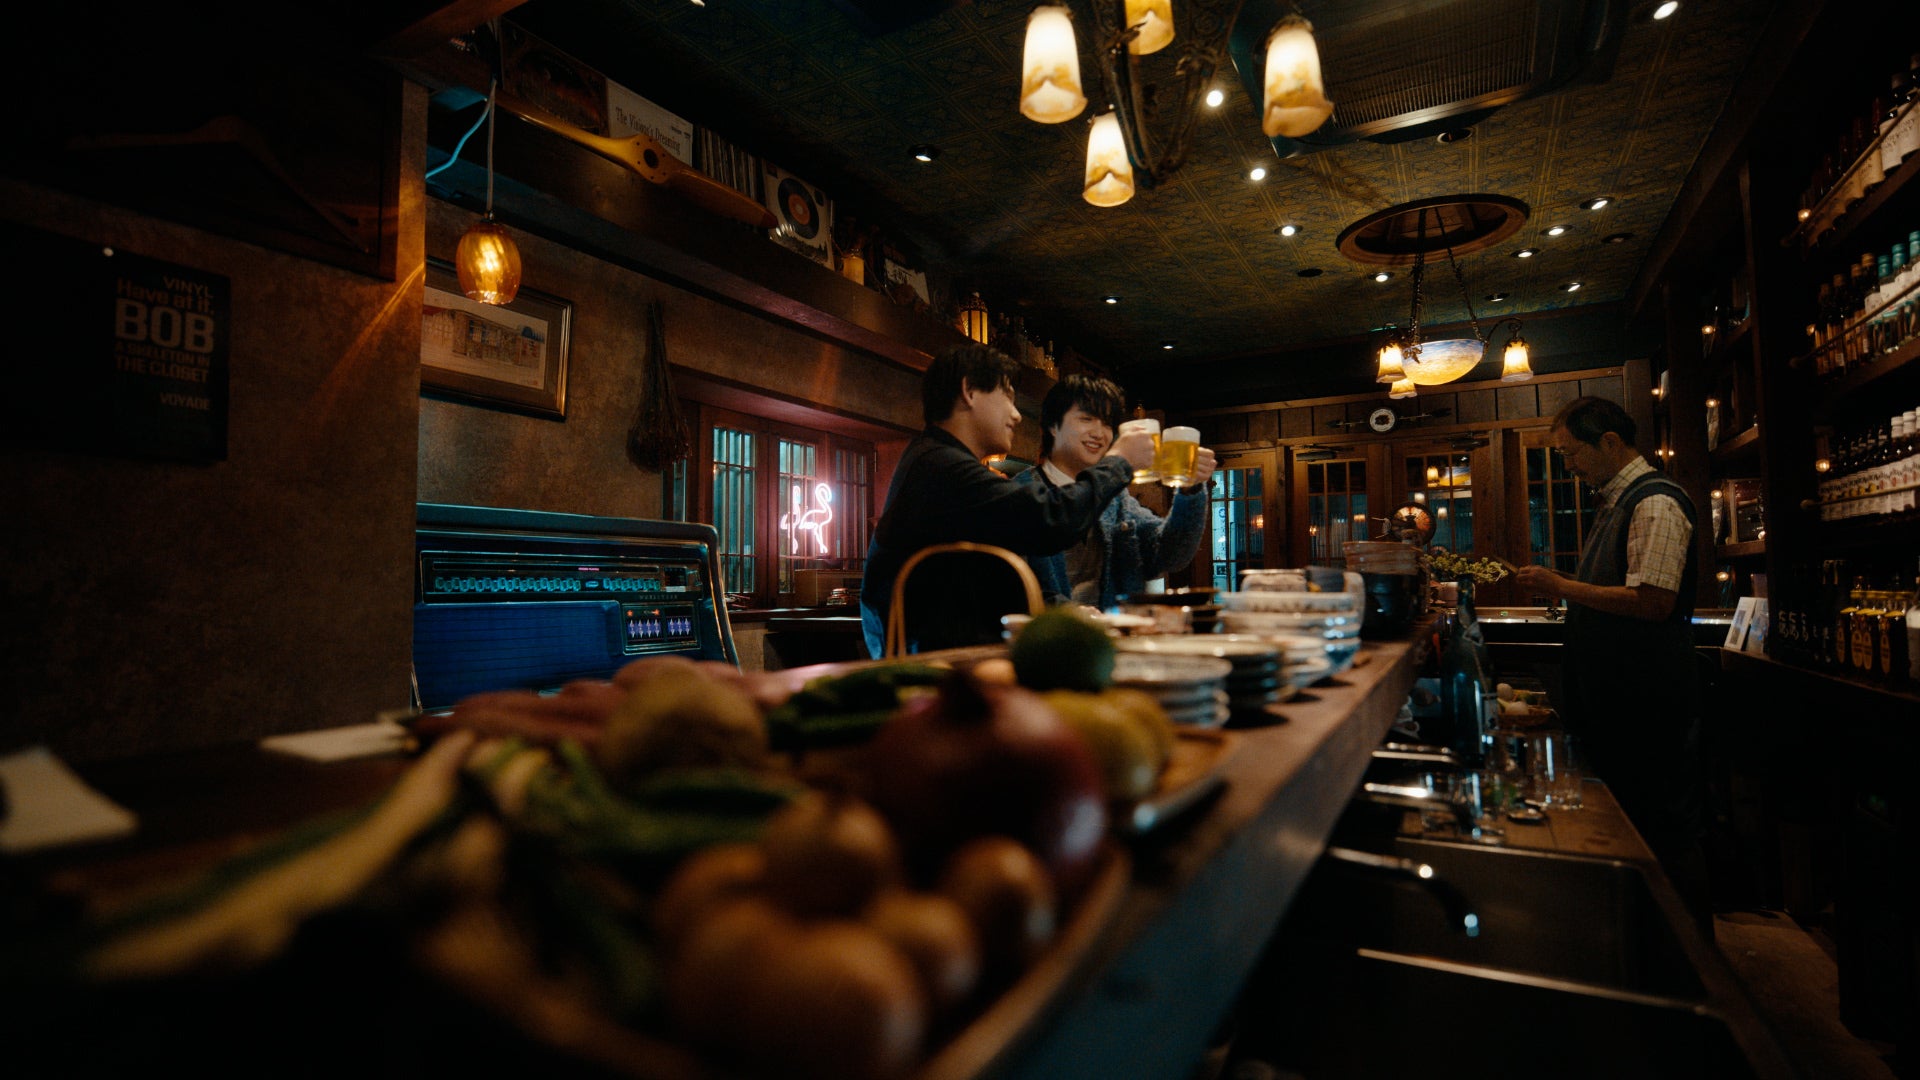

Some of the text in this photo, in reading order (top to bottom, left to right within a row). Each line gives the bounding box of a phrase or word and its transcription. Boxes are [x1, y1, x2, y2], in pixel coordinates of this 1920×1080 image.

[615, 106, 628, 126] The
[116, 277, 169, 304] Have
[173, 294, 192, 310] at
[162, 275, 214, 298] VINYL
[114, 297, 214, 354] BOB
[114, 355, 146, 373] THE
